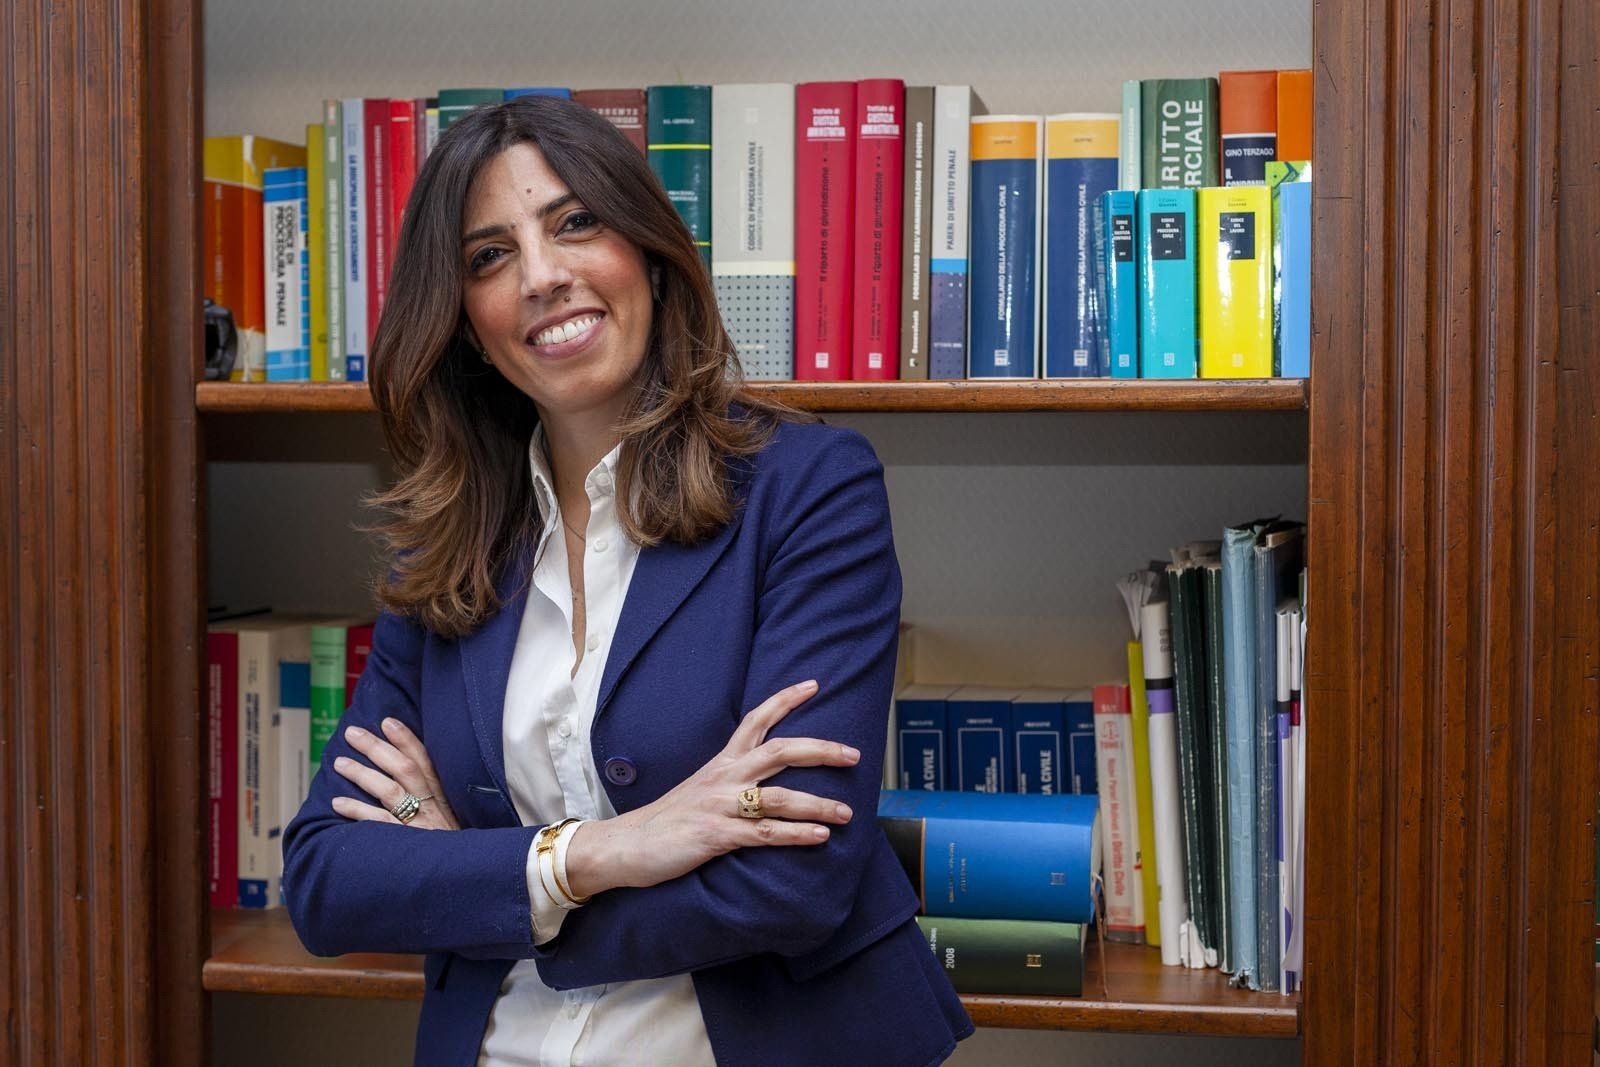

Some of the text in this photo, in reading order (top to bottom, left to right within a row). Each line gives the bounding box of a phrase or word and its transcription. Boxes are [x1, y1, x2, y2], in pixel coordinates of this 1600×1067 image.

[915, 122, 923, 159] SOSTEGNO
[1184, 100, 1203, 190] RCIALE
[1225, 147, 1274, 157] GINO TERZAGO
[821, 167, 830, 226] giurisdizione
[874, 172, 883, 228] giurisdizione
[946, 150, 956, 250] PARERI DI DIRITTO PENALE
[748, 213, 755, 222] DI
[821, 228, 828, 238] di
[874, 230, 882, 239] di
[285, 205, 295, 265] CODICE DI
[275, 206, 287, 327] PROCEDURA PENALE
[820, 240, 829, 274] riparto
[873, 240, 882, 274] riparto
[998, 184, 1007, 321] FORMULARIO DELLA PROCEDURA CIVILE
[1077, 184, 1087, 321] FORMULARIO DELLA PROCEDURA CIVILE
[912, 254, 920, 300] FORMULARIO
[922, 749, 934, 780] CIVILE
[1039, 750, 1051, 782] CIVILE
[1112, 841, 1125, 869] Diritto
[1114, 870, 1126, 897] Civile
[945, 947, 955, 969] 2008
